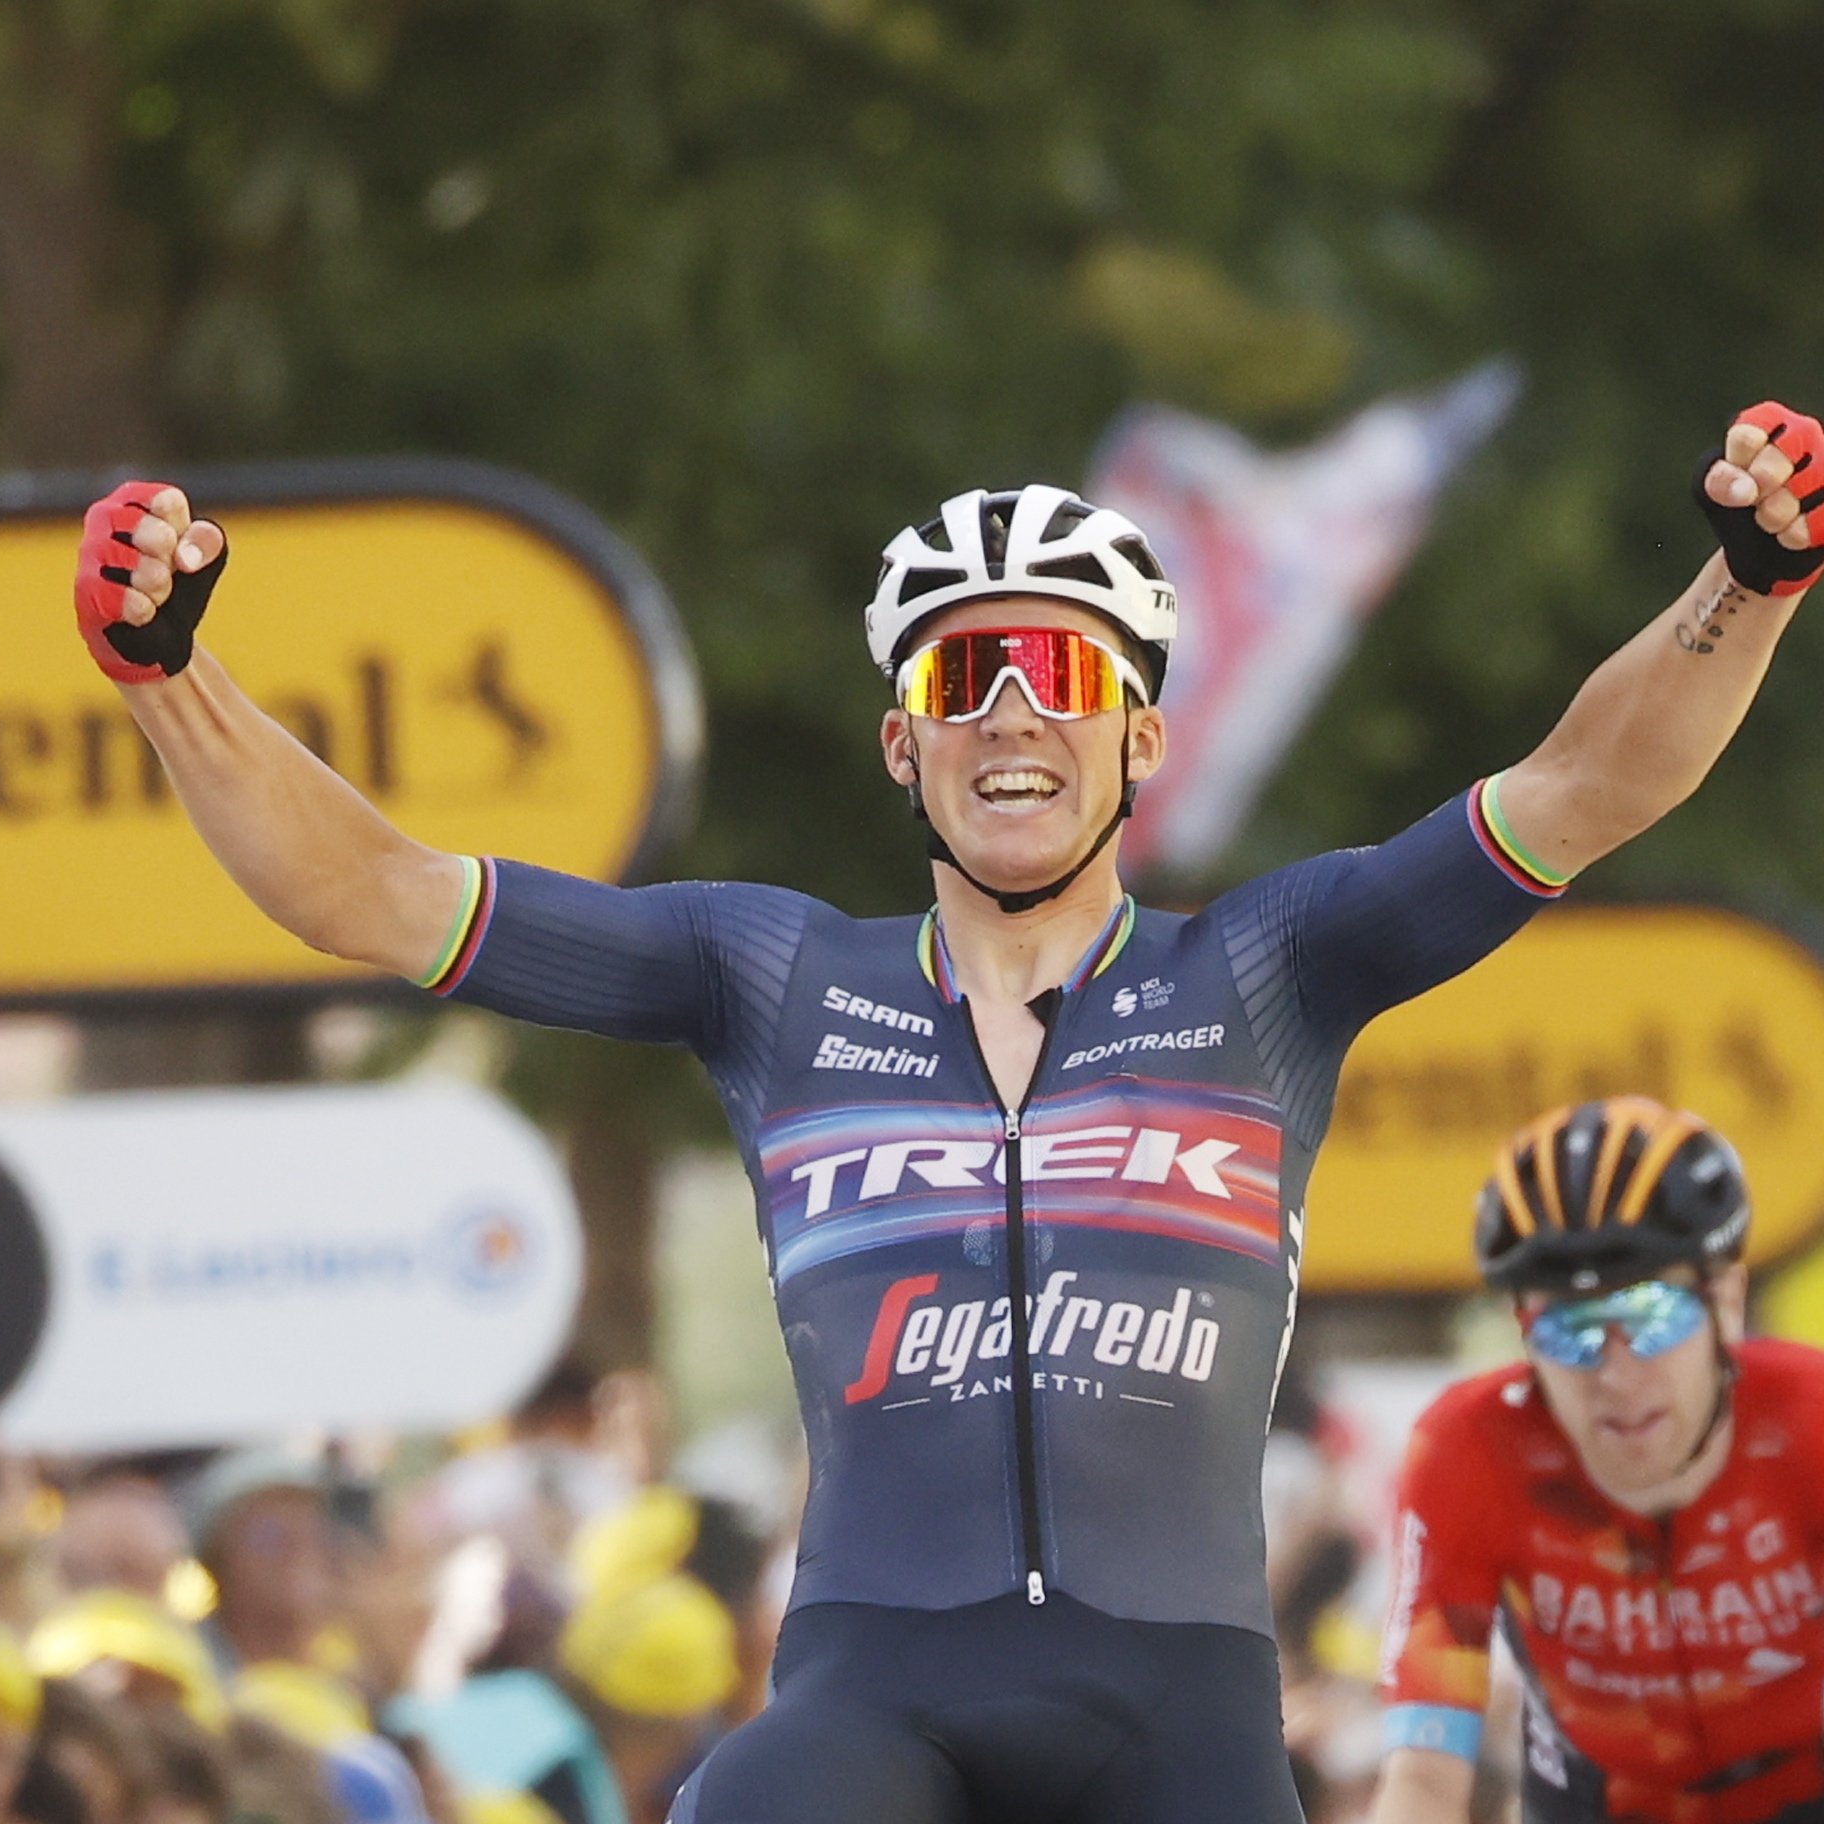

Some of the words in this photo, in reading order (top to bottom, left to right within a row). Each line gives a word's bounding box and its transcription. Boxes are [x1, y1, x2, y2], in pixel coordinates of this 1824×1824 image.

[1140, 977, 1160, 992] UCI
[1141, 981, 1176, 1001] WORLD
[1142, 994, 1170, 1010] TEAM
[822, 985, 935, 1037] SRAM
[812, 1033, 940, 1078] Santini
[1061, 1024, 1225, 1070] BONTRAGER
[791, 1125, 1241, 1220] TREK
[844, 1270, 1220, 1405] Segafredo
[1532, 1562, 1814, 1632] BAHRAIN
